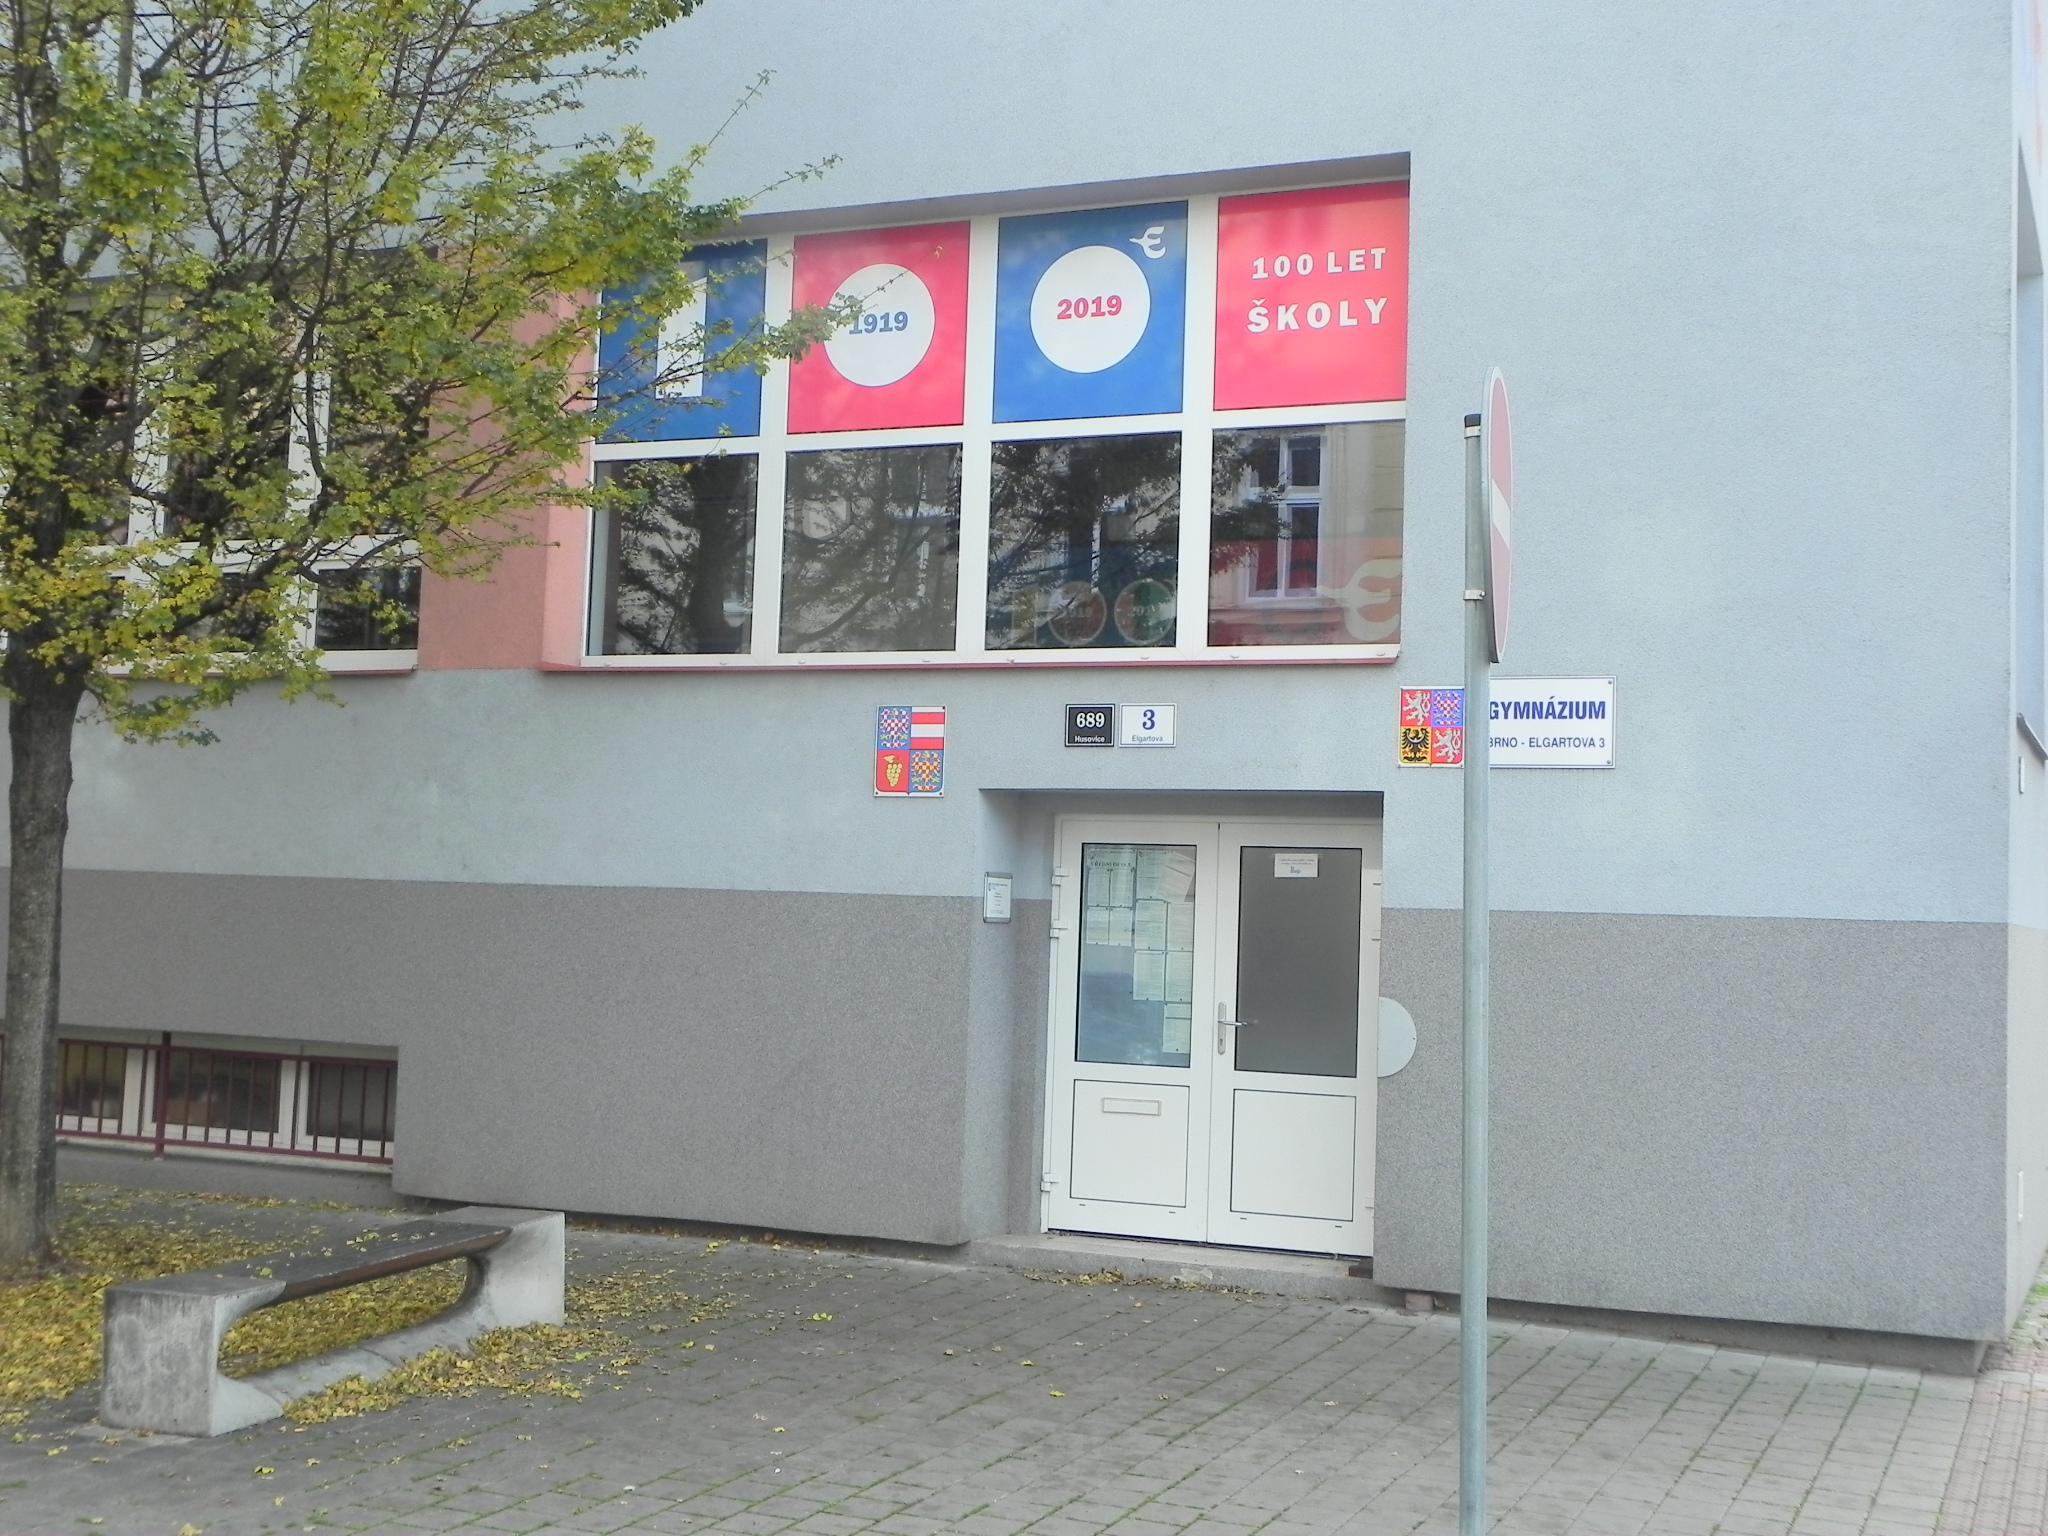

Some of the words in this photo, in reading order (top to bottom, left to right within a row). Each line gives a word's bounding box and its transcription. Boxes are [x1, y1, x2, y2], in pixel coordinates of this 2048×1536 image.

[1252, 253, 1314, 280] 100
[1326, 247, 1387, 274] LET
[1057, 294, 1123, 320] 2019
[1247, 298, 1388, 333] ŠKOLY
[848, 311, 909, 335] 1919
[1489, 696, 1606, 720] GYMNÁZIUM
[1076, 712, 1105, 728] 689
[1142, 709, 1155, 730] 3
[1074, 735, 1106, 743] Husovice
[1131, 734, 1164, 744] Elgartova
[1528, 737, 1596, 748] ELGARTOVA
[1598, 737, 1606, 748] 3
